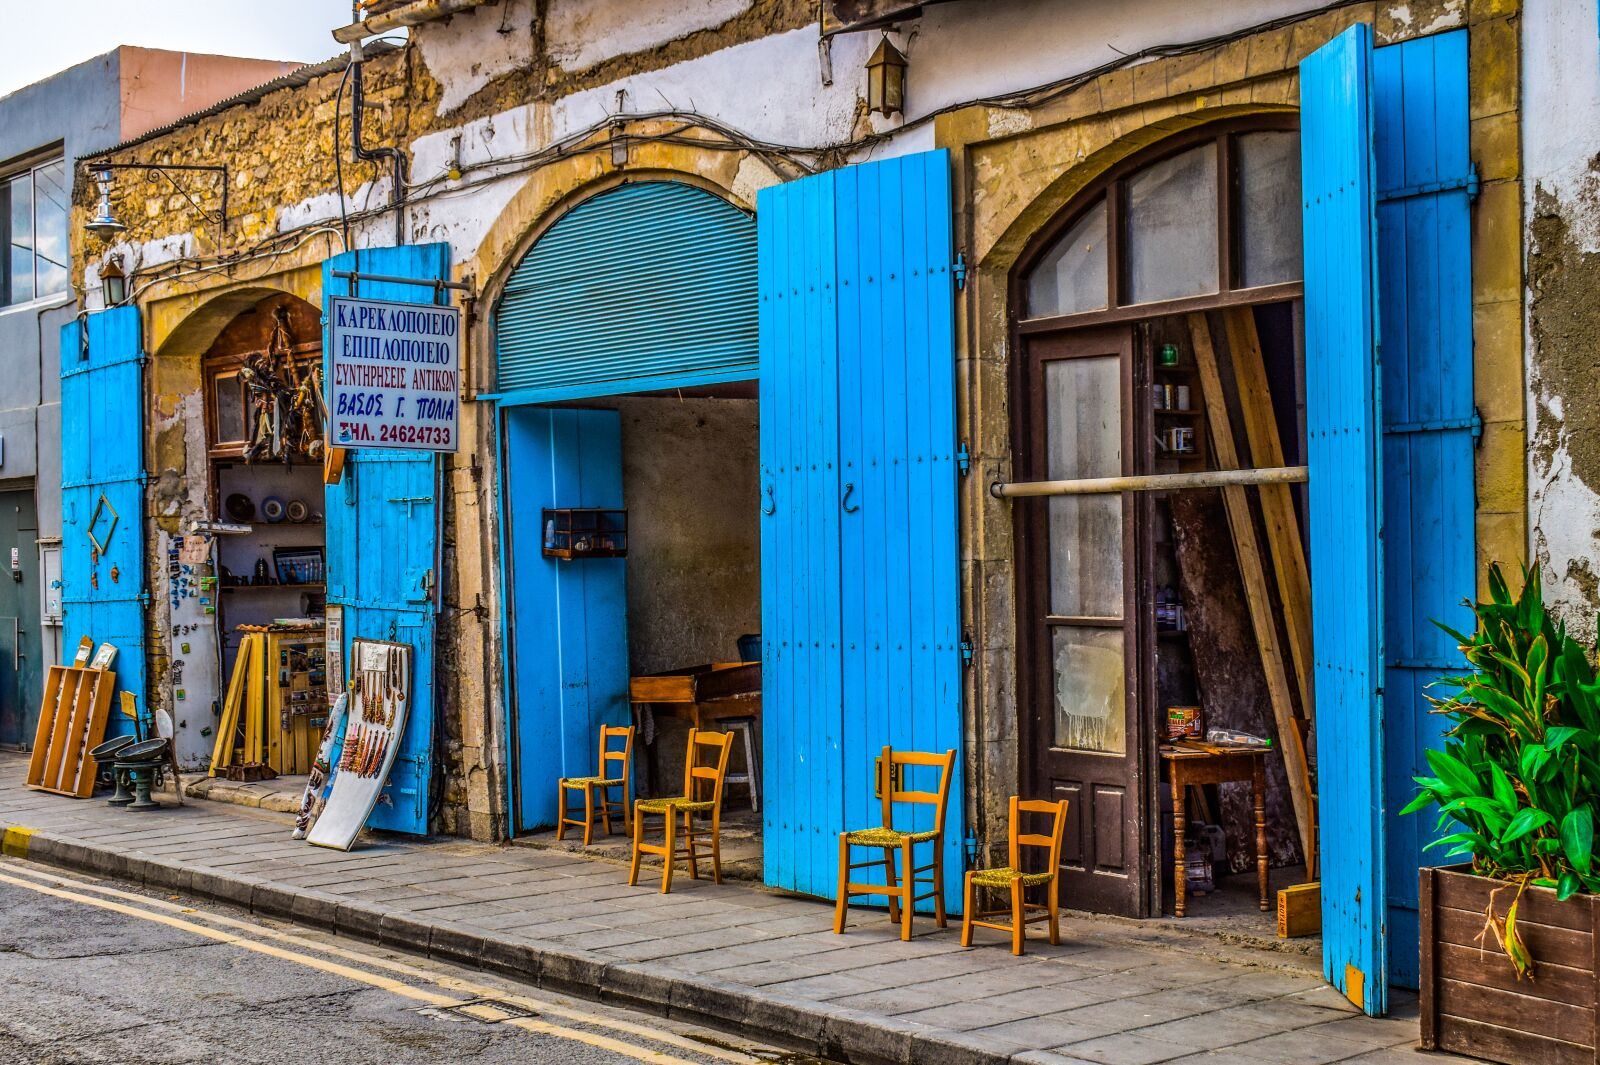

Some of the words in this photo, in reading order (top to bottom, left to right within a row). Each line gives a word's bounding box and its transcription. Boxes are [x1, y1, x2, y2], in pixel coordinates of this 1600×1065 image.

[338, 305, 455, 336] ΚΑΡΕΚΛΟΠΟΙΕΙΟ
[342, 335, 450, 364] ΕΠΙΠΛΟΠΟΙΕΙΟ
[336, 363, 406, 389] ΣΥΝΤΗΡΗΣΕΙΣ
[412, 368, 455, 392] ΑΝΤΙΚΩΝ
[337, 392, 384, 417] ΒΑΣΟΣ
[395, 396, 405, 418] Γ.
[380, 424, 450, 444] 24624733
